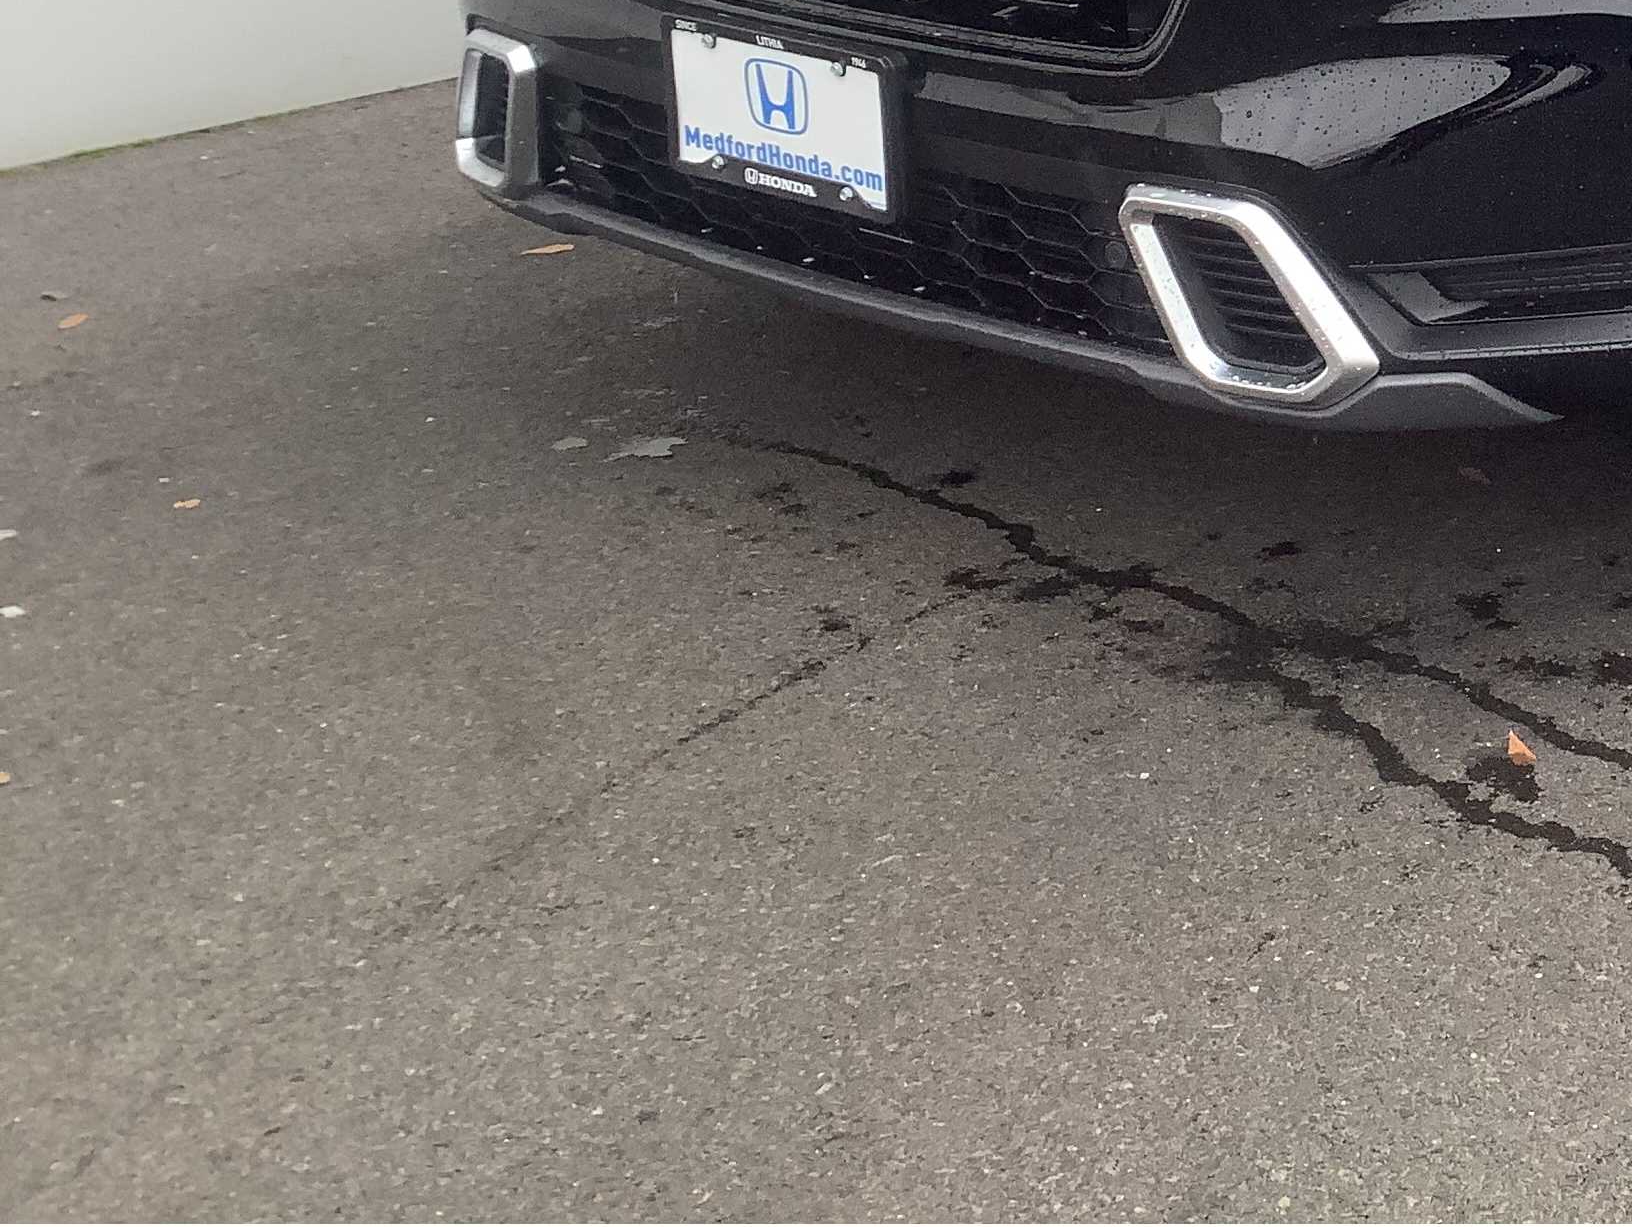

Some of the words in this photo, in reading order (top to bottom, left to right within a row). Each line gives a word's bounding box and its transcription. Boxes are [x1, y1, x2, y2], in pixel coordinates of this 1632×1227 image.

[755, 34, 784, 50] LITHIA
[684, 125, 882, 191] MedfordHonda.com
[758, 173, 818, 198] HONDA
